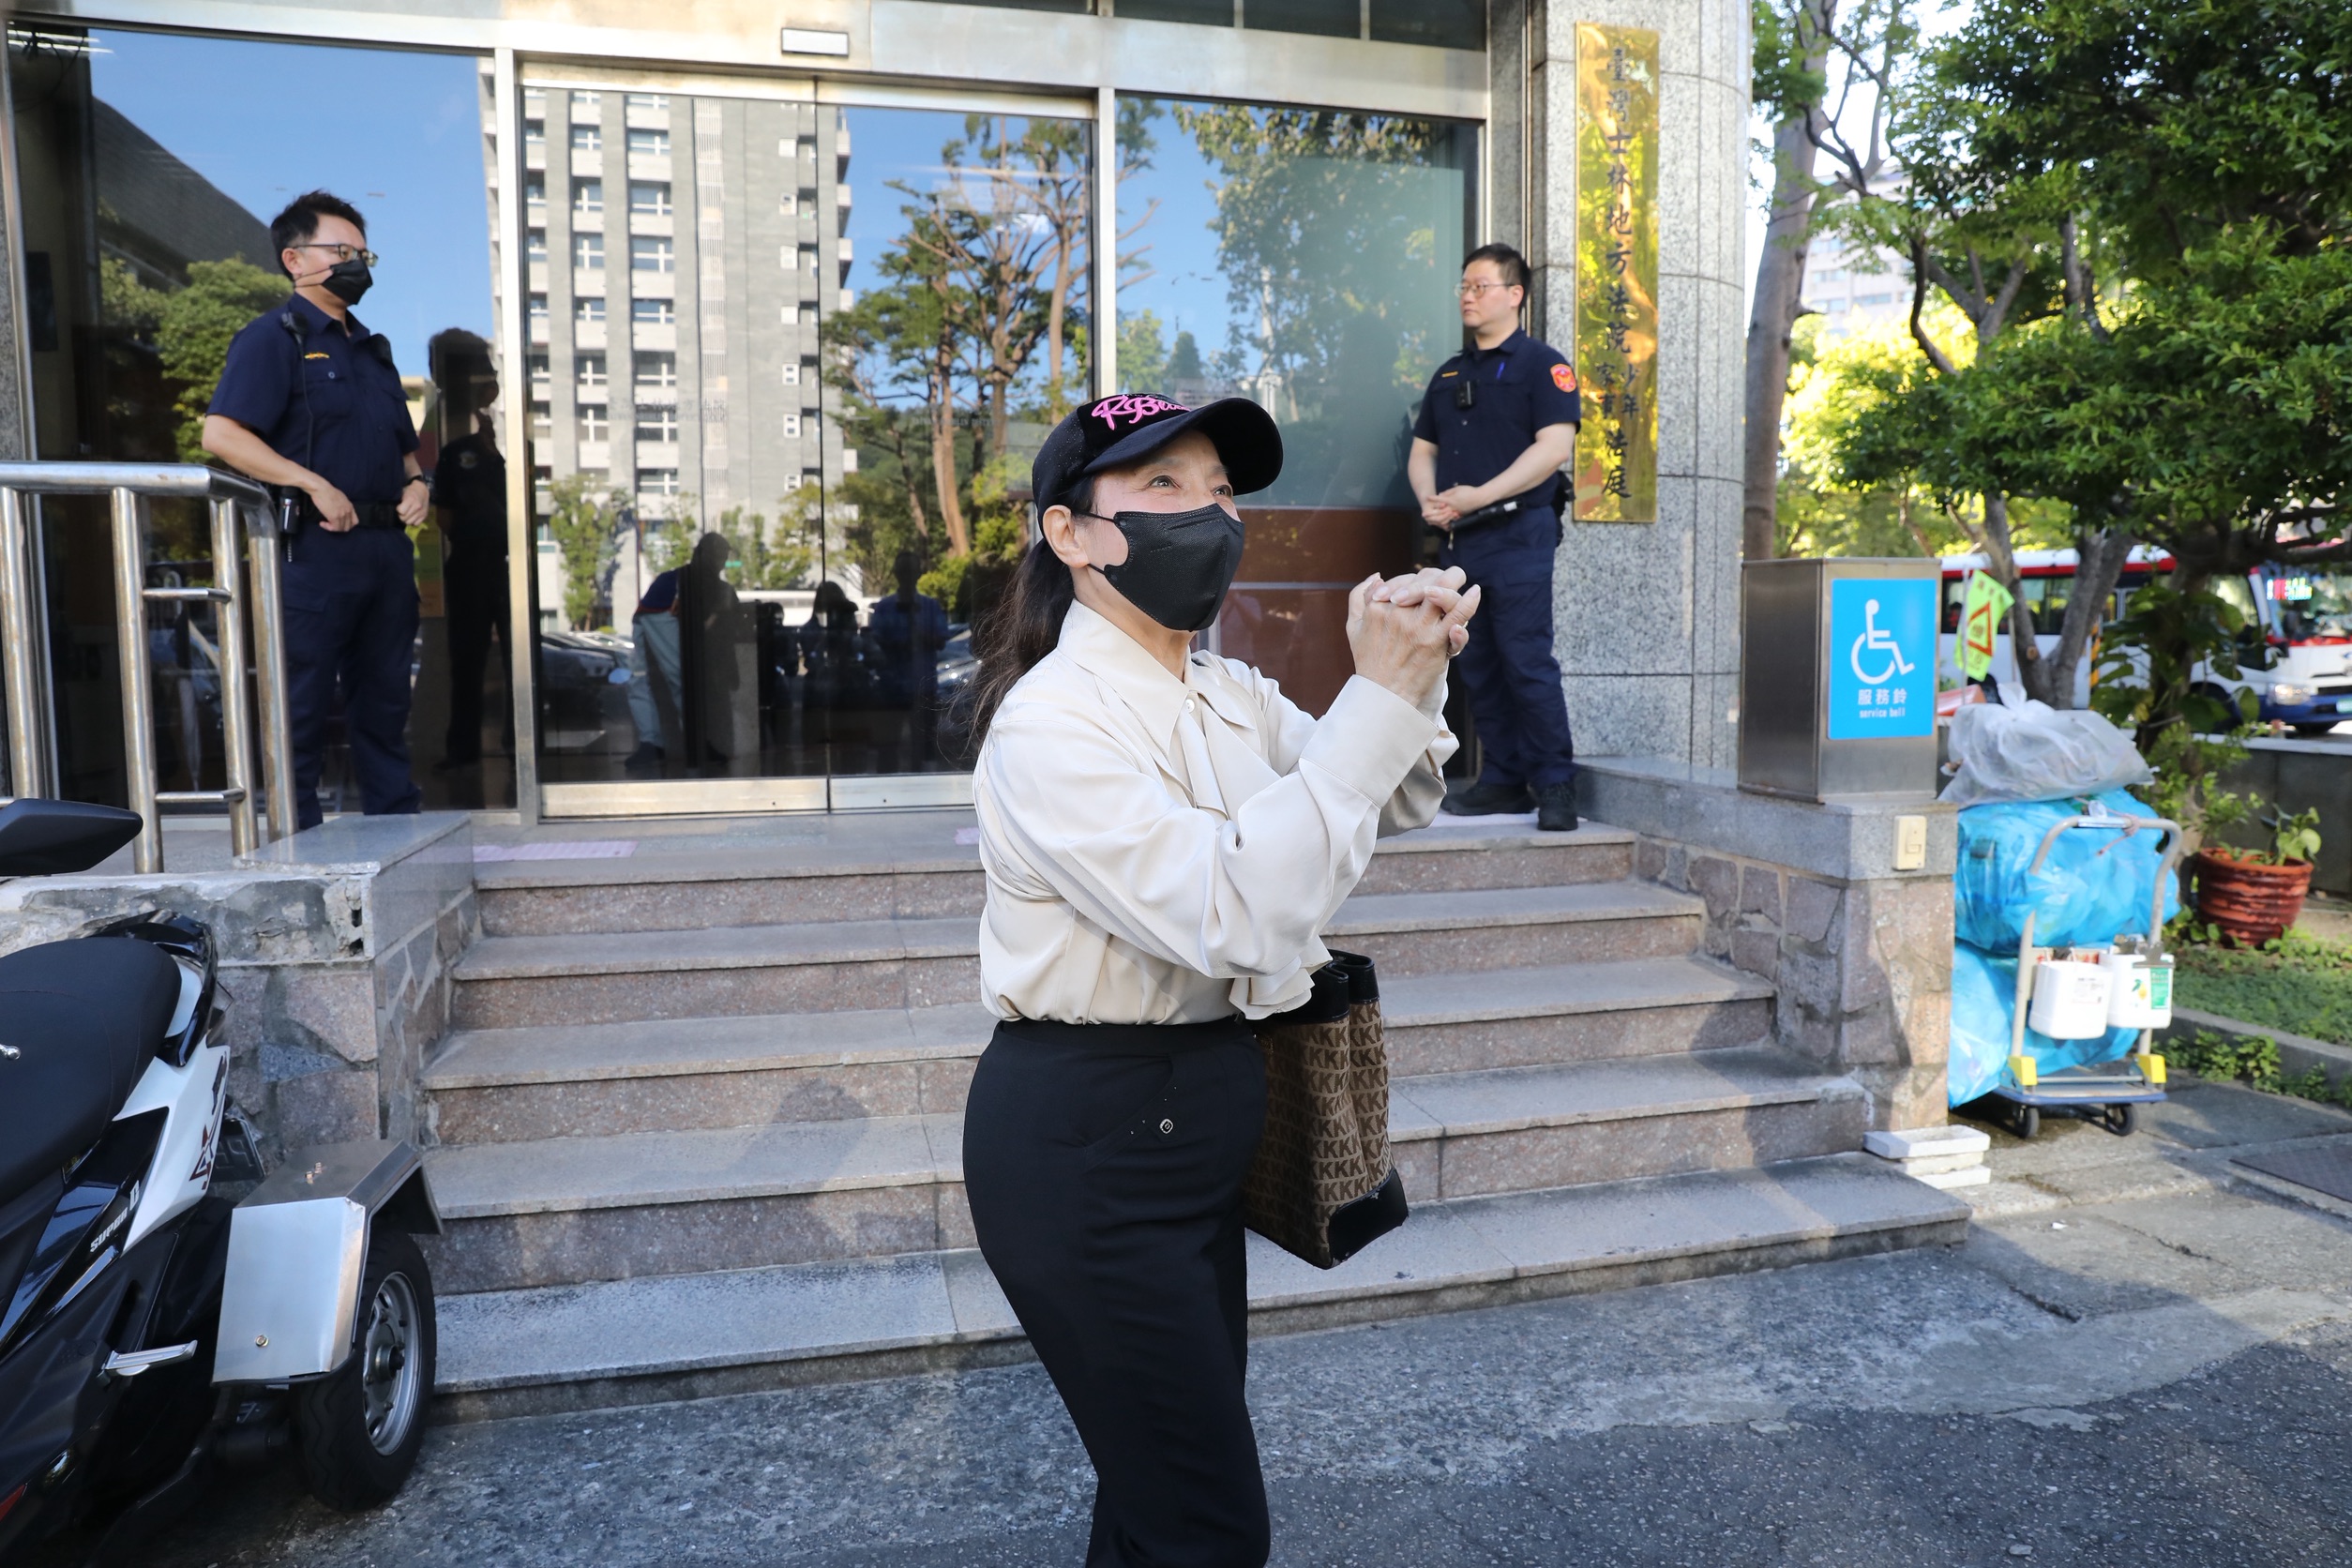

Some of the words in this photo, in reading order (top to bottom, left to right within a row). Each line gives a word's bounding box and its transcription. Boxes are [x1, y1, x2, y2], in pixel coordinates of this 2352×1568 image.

[1602, 428, 1633, 499] 法庭
[1858, 687, 1907, 705] 服務鈴
[1860, 708, 1887, 718] service
[1890, 706, 1906, 717] bell
[90, 1207, 128, 1252] SUPER
